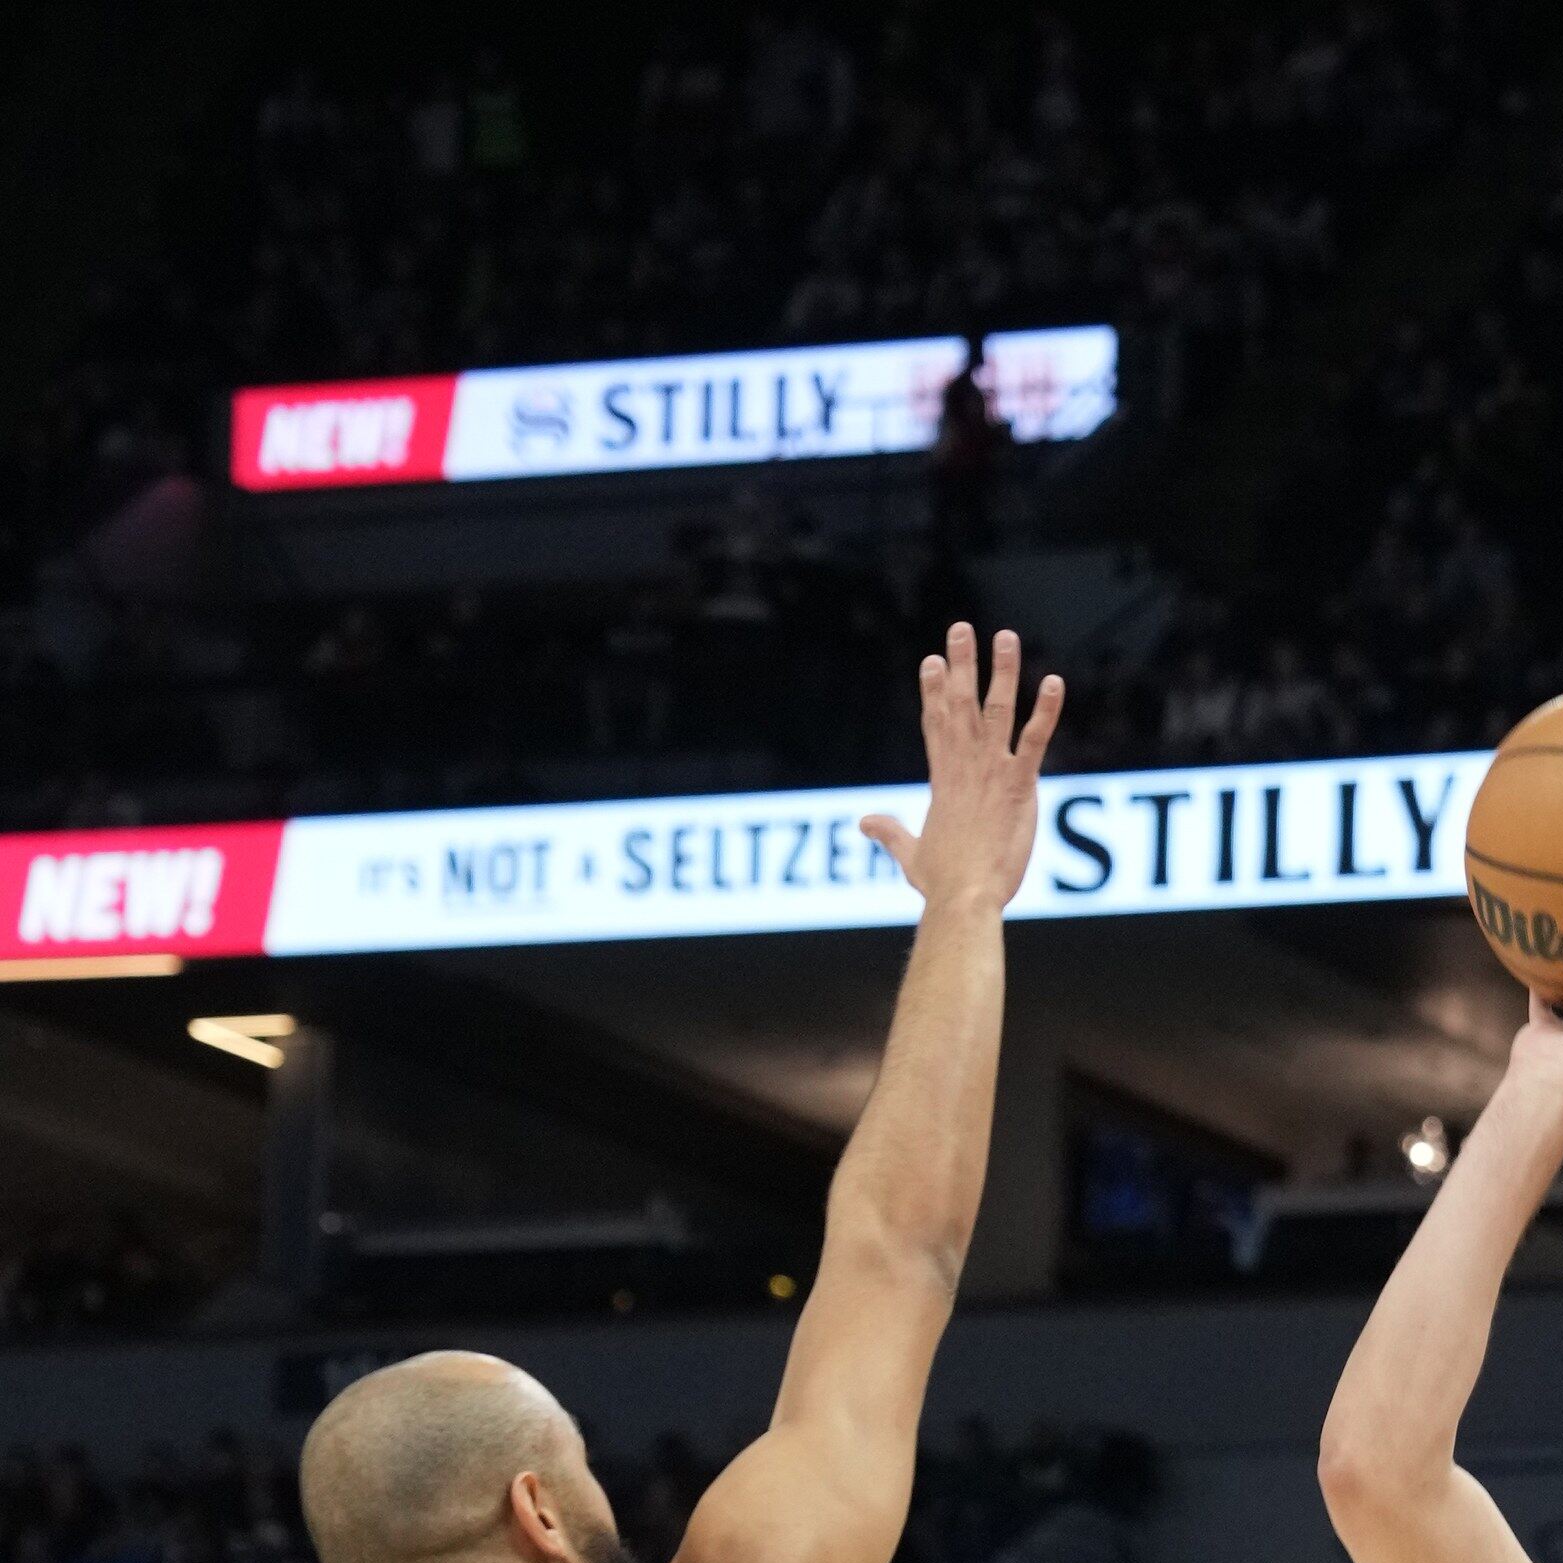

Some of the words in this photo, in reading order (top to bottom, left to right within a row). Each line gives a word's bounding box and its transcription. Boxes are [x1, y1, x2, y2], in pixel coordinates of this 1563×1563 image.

[259, 394, 417, 476] NEW!
[602, 370, 848, 451] STILLY
[444, 838, 554, 900] NOT
[1052, 772, 1457, 894] STILLY
[18, 846, 225, 943] NEW!
